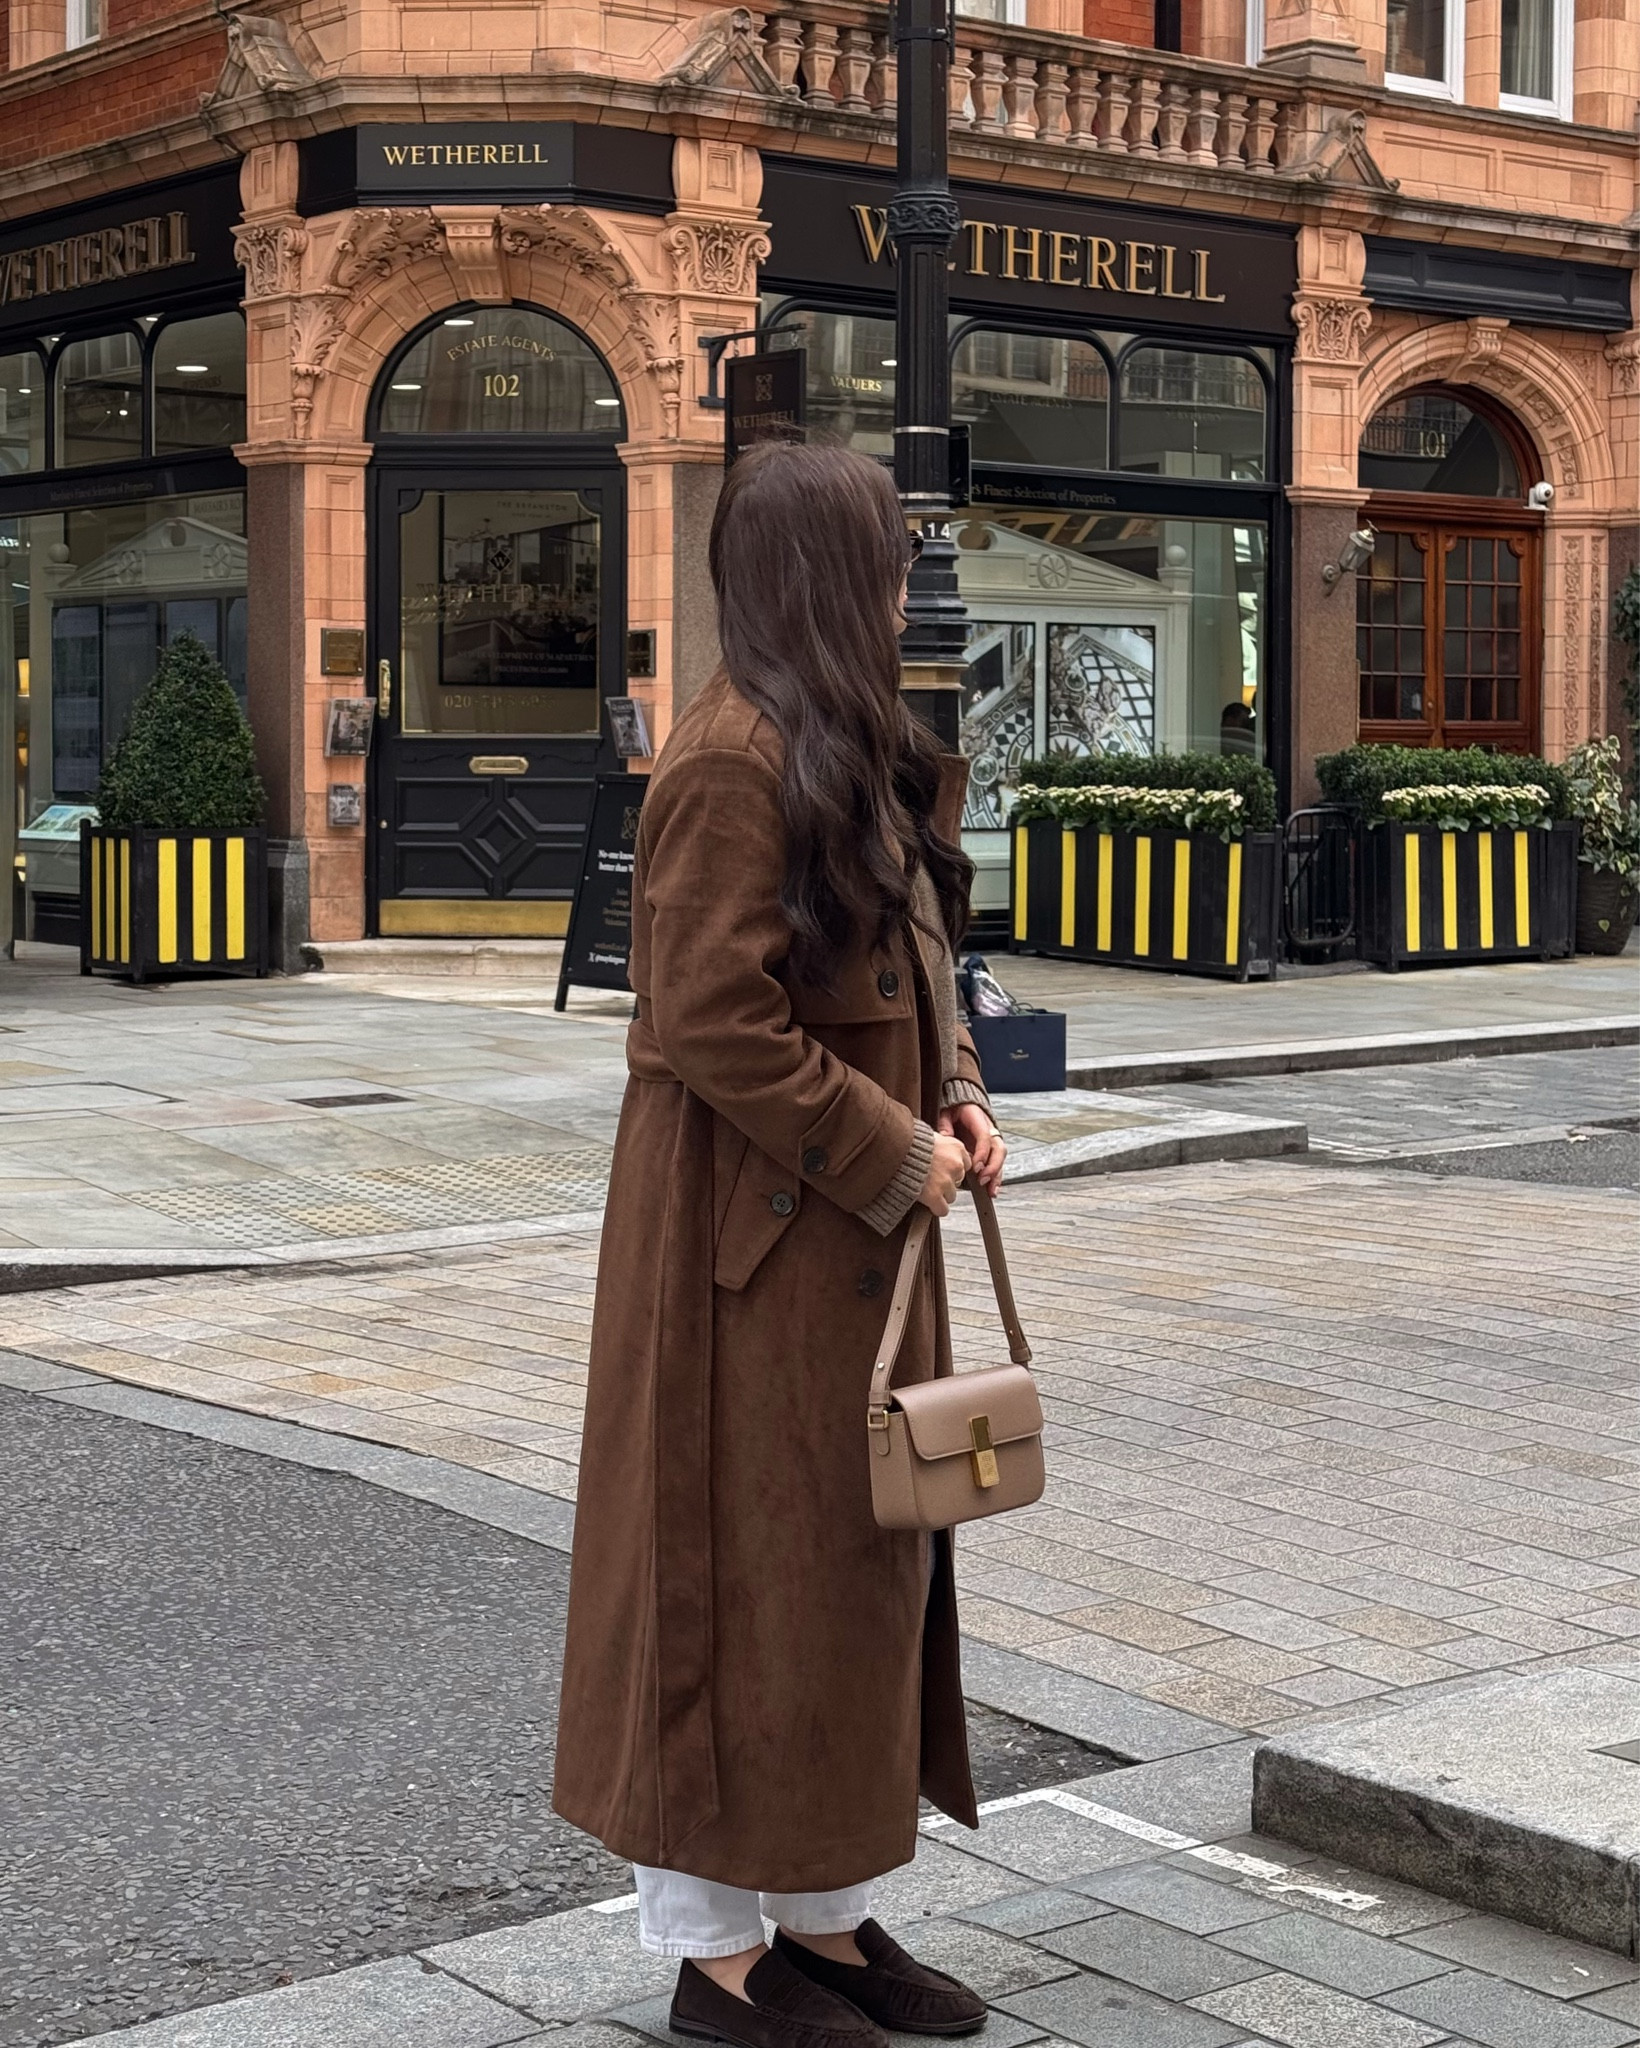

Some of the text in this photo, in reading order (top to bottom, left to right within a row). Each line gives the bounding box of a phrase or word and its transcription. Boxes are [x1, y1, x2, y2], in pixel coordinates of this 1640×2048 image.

[382, 143, 549, 166] WETHERELL
[850, 204, 1226, 303] WTHERELL
[446, 335, 557, 362] ESTATE AGENTS
[484, 374, 520, 397] 102
[830, 375, 883, 393] VALUERS
[1420, 430, 1446, 458] 101
[983, 483, 1013, 498] Finest
[1014, 486, 1057, 500] Selection
[1057, 488, 1069, 501] of
[1069, 490, 1117, 506] Properties
[927, 523, 951, 539] 14
[444, 694, 472, 709] 020
